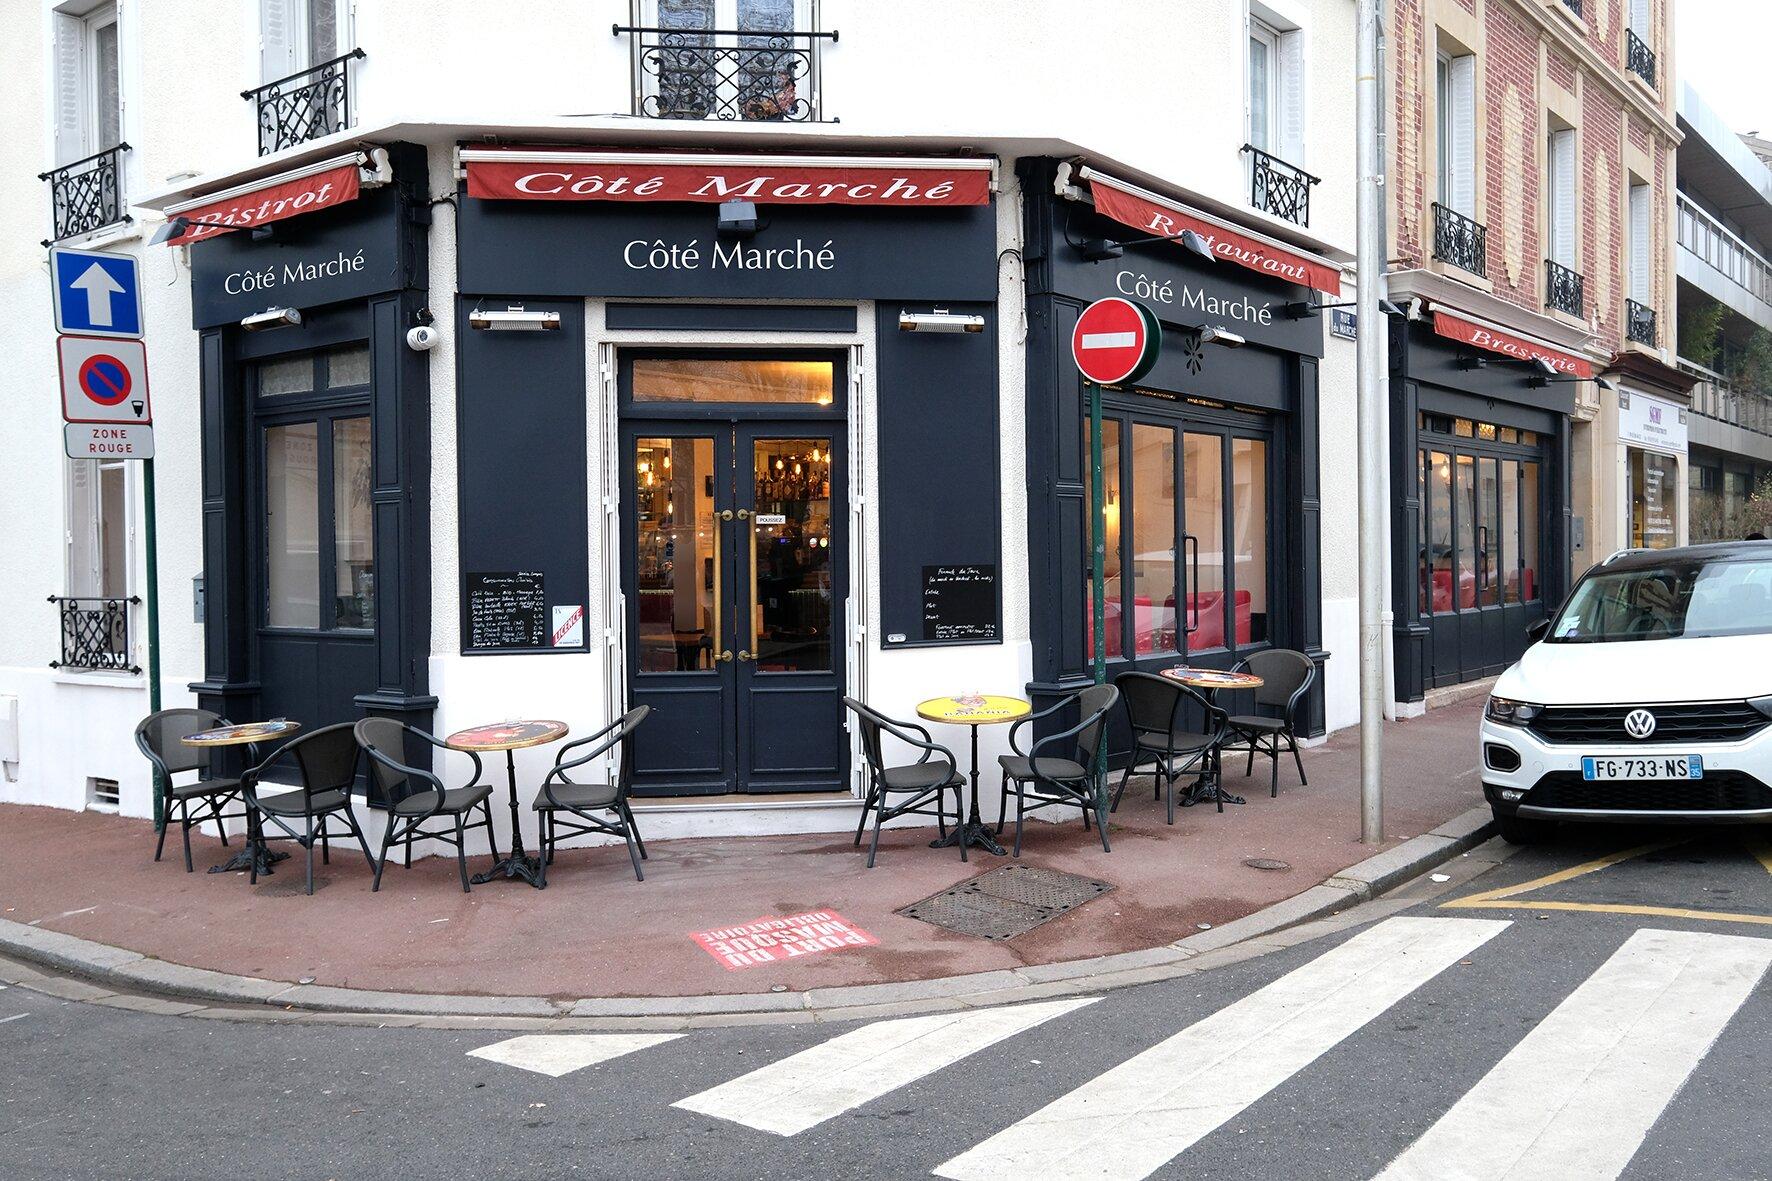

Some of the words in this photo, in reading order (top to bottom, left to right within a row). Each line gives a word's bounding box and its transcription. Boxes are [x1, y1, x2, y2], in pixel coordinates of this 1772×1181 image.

[514, 171, 664, 196] Côté
[687, 175, 957, 200] Marché
[187, 183, 333, 238] Bistrot
[623, 238, 700, 270] Côté
[711, 239, 836, 270] Marché
[1145, 211, 1306, 279] Rtaurant
[224, 266, 275, 295] Côté
[283, 249, 365, 285] Marché
[1116, 271, 1173, 304] Côté
[1181, 284, 1273, 326] Marché
[89, 443, 133, 453] ROUGE
[93, 429, 127, 438] ZONE
[554, 607, 583, 642] LICENCE
[700, 912, 832, 943] OBLIGATOIRE
[715, 920, 850, 956] MASQUE
[725, 949, 775, 967] DU
[781, 931, 868, 957] PORT
